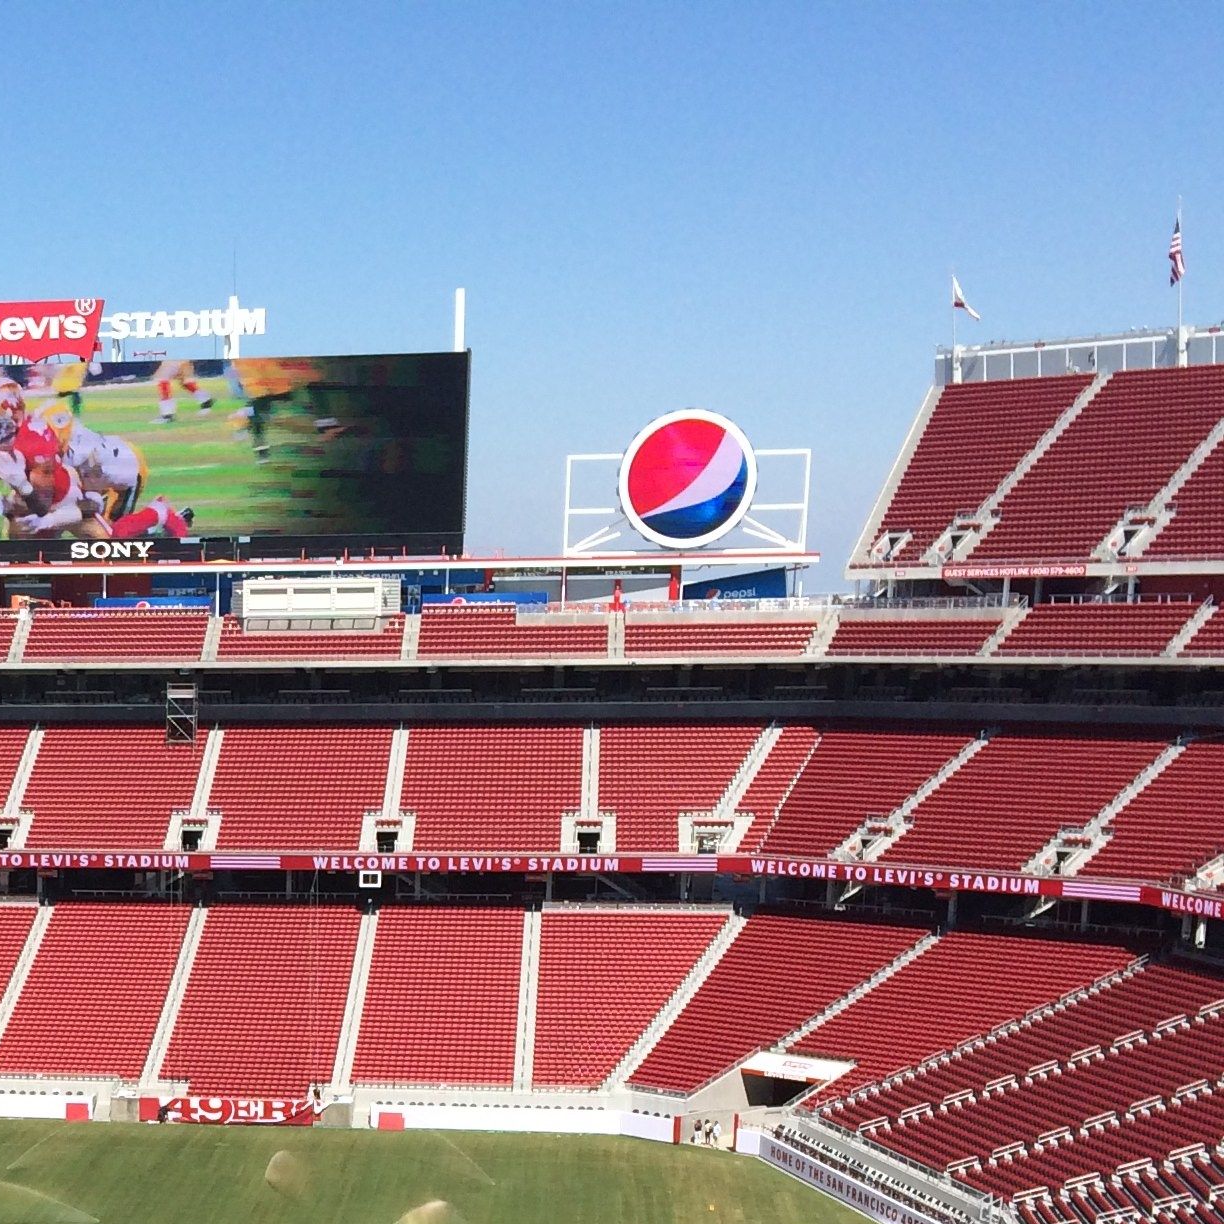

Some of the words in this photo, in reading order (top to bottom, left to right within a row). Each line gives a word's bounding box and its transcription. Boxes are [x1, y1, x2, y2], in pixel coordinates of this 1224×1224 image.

[111, 308, 266, 339] STADIUM
[70, 541, 154, 559] SONY
[0, 854, 21, 867] TO
[103, 854, 190, 869] STADIUM
[312, 856, 408, 870] WELCOME
[416, 857, 441, 870] TO
[528, 857, 619, 872] STADIUM
[751, 860, 837, 879] WELCOME
[844, 866, 867, 881] TO
[949, 874, 1040, 894] STADIUM
[1161, 891, 1222, 918] WELCOME
[771, 1145, 793, 1167] HOME
[795, 1158, 806, 1173] OF
[809, 1165, 824, 1183] THE
[826, 1174, 844, 1194] SAN
[846, 1184, 898, 1222] FRANCISCO
